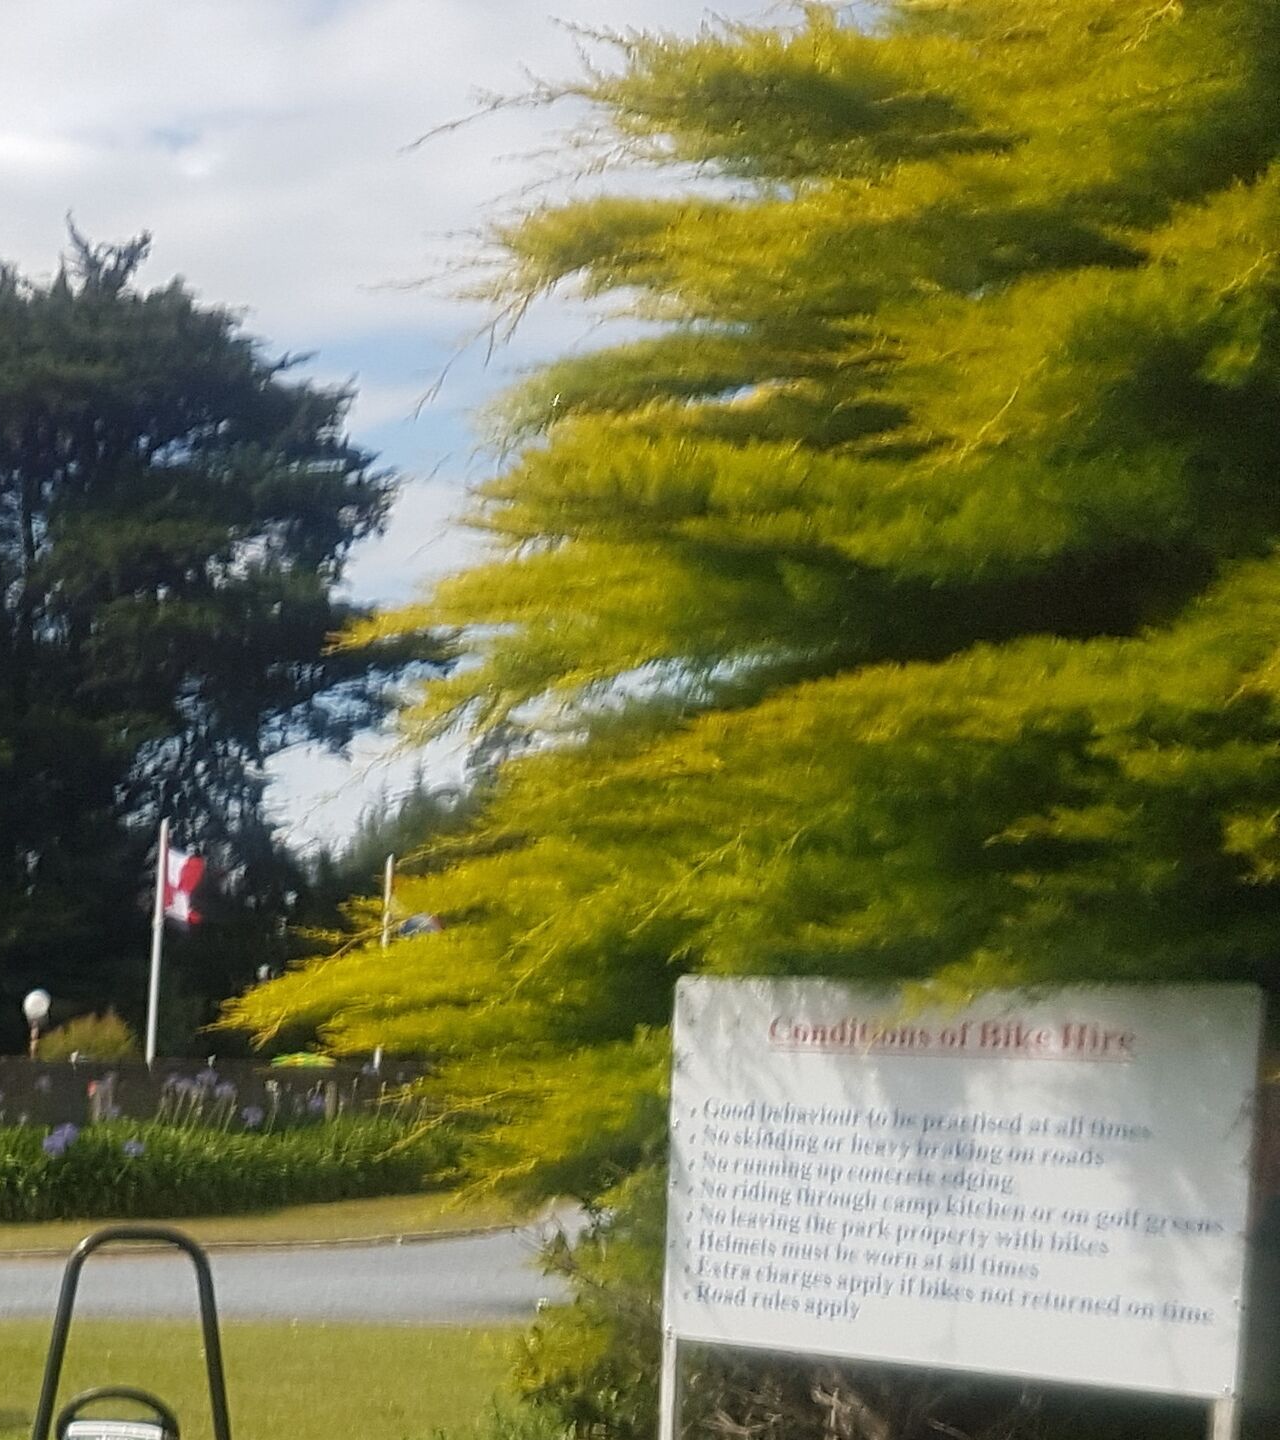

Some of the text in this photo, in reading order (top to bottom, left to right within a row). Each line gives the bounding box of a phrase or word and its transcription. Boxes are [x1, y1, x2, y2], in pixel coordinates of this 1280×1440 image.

[938, 1020, 972, 1047] of
[980, 1020, 1049, 1049] Bike
[1060, 1023, 1136, 1051] Hire
[703, 1098, 756, 1119] Good
[760, 1102, 859, 1126] behaviour
[867, 1108, 888, 1127] to
[893, 1108, 913, 1127] be
[1028, 1115, 1049, 1133] at
[1056, 1115, 1084, 1136] all
[1091, 1116, 1153, 1139] times
[702, 1124, 729, 1146] No
[734, 1127, 819, 1153] skidding
[824, 1136, 845, 1151] or
[851, 1132, 910, 1159] heavy
[1007, 1147, 1035, 1162] on
[1040, 1147, 1105, 1166] roads
[702, 1151, 1014, 1194] No running up concrete edging
[701, 1177, 1225, 1235] No riding through camp kitchen or on golf greens
[699, 1203, 1110, 1254] No leaving the park property with bikes
[699, 1230, 1040, 1279] Helmets must be worn at all times
[697, 1255, 751, 1279] Extra
[756, 1262, 832, 1289] charges
[836, 1270, 893, 1297] apply
[899, 1273, 916, 1293] if
[919, 1277, 975, 1299] bikes
[981, 1287, 1014, 1305] not
[1021, 1290, 1121, 1315] returned
[1127, 1301, 1154, 1317] on
[697, 1282, 860, 1320] Road rules apply
